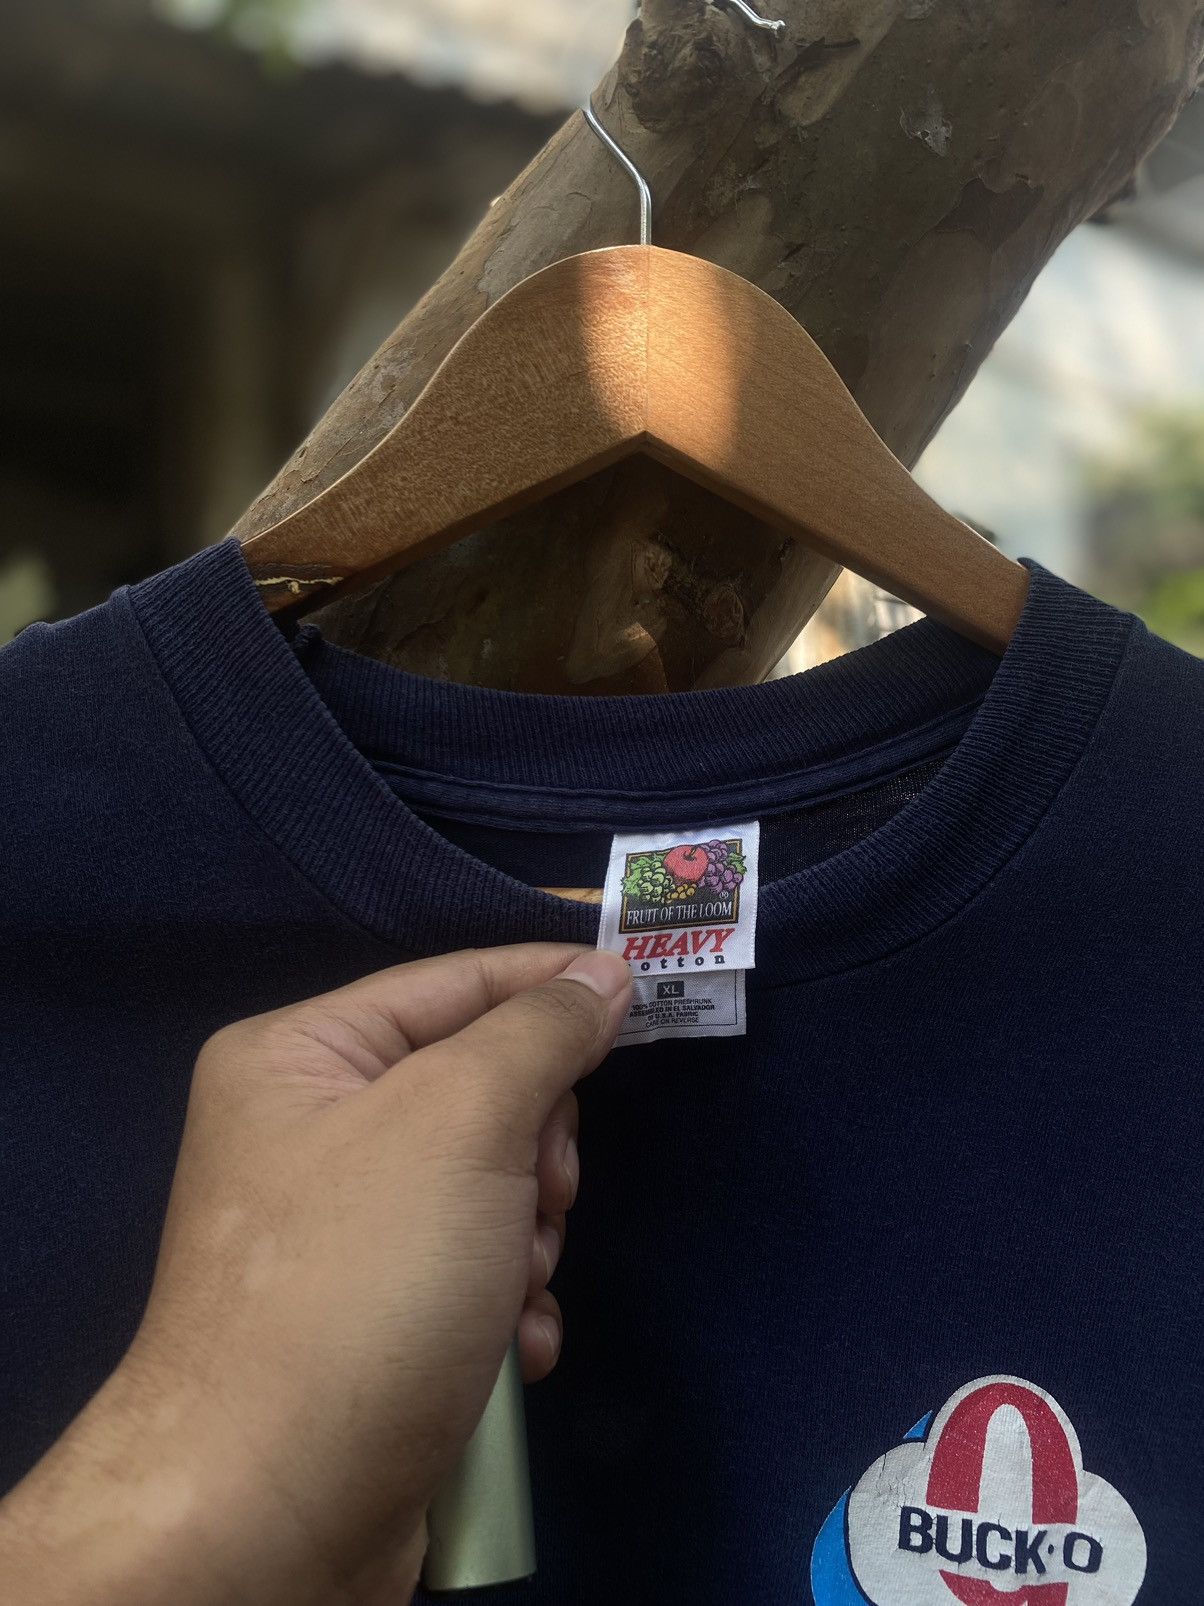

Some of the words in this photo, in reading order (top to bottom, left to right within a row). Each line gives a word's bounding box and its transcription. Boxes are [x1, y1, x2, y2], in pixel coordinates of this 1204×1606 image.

[627, 908, 657, 926] FRUIT
[660, 906, 675, 921] OF
[676, 904, 697, 920] THE
[699, 900, 732, 919] LOOM
[622, 928, 736, 961] HEAVY
[627, 955, 725, 972] otton
[663, 984, 680, 995] XL
[649, 1000, 673, 1008] COTTON
[674, 998, 712, 1006] PRESHRUNK
